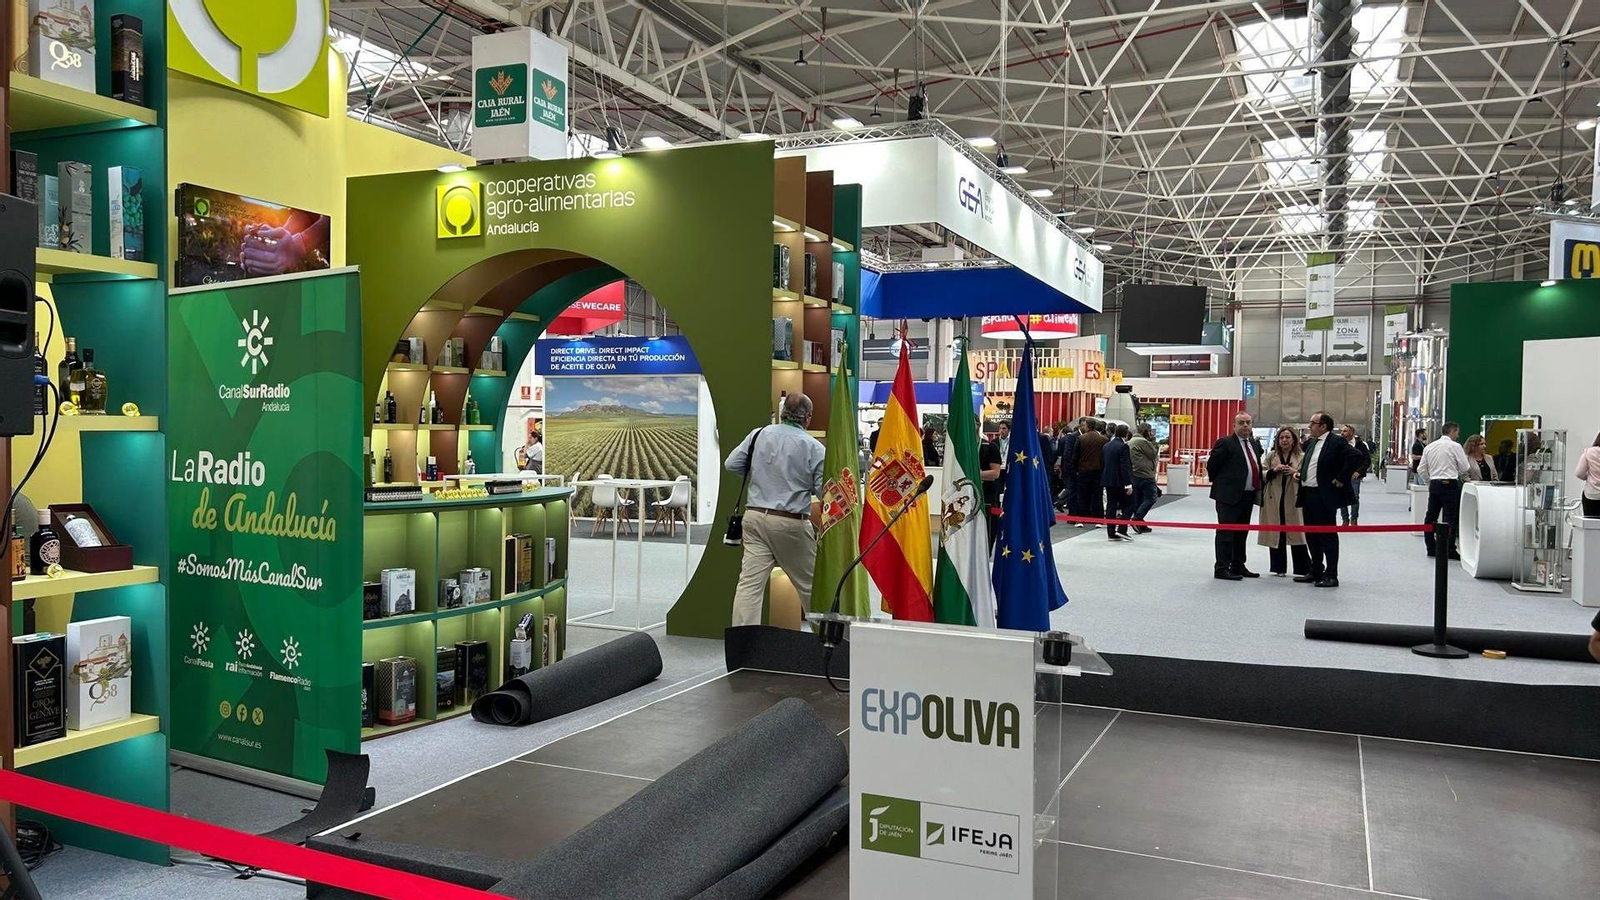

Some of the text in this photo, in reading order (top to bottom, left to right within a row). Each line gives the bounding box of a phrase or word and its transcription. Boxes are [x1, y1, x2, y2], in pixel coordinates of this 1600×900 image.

[49, 41, 82, 70] Q58
[477, 96, 525, 108] CAJA RURAL
[533, 96, 564, 116] CAJA RURAL
[490, 107, 511, 118] JAÉN
[542, 109, 556, 121] JAÉN
[486, 172, 596, 197] cooperativas
[486, 190, 636, 219] agro-alimentarias
[958, 177, 984, 219] GEA
[486, 221, 540, 235] Andalucía
[1073, 257, 1087, 284] GEA
[550, 353, 686, 363] EFICIENCIA DIRECTA EN TÚ PRODUCCIÓN
[575, 347, 597, 355] DRIVE.
[624, 346, 650, 354] IMPACT
[975, 361, 1017, 380] SPAI
[218, 383, 290, 399] CanalSurRadio
[261, 401, 290, 412] Andalucía
[192, 486, 336, 542] de Andalucía
[177, 553, 323, 591] #SomosMásCanalSur
[184, 655, 214, 669] CanalFiesta
[225, 661, 238, 673] rai
[269, 671, 312, 687] FlamencoRadio
[88, 682, 118, 711] Q58
[861, 687, 1020, 749] EXPOLIVA
[218, 733, 262, 750] www.canalsur.es
[879, 822, 914, 834] DIPUTACIÓN
[888, 830, 902, 838] JAÉN
[951, 826, 1013, 850] IFEJA
[980, 849, 997, 857] FERIAS
